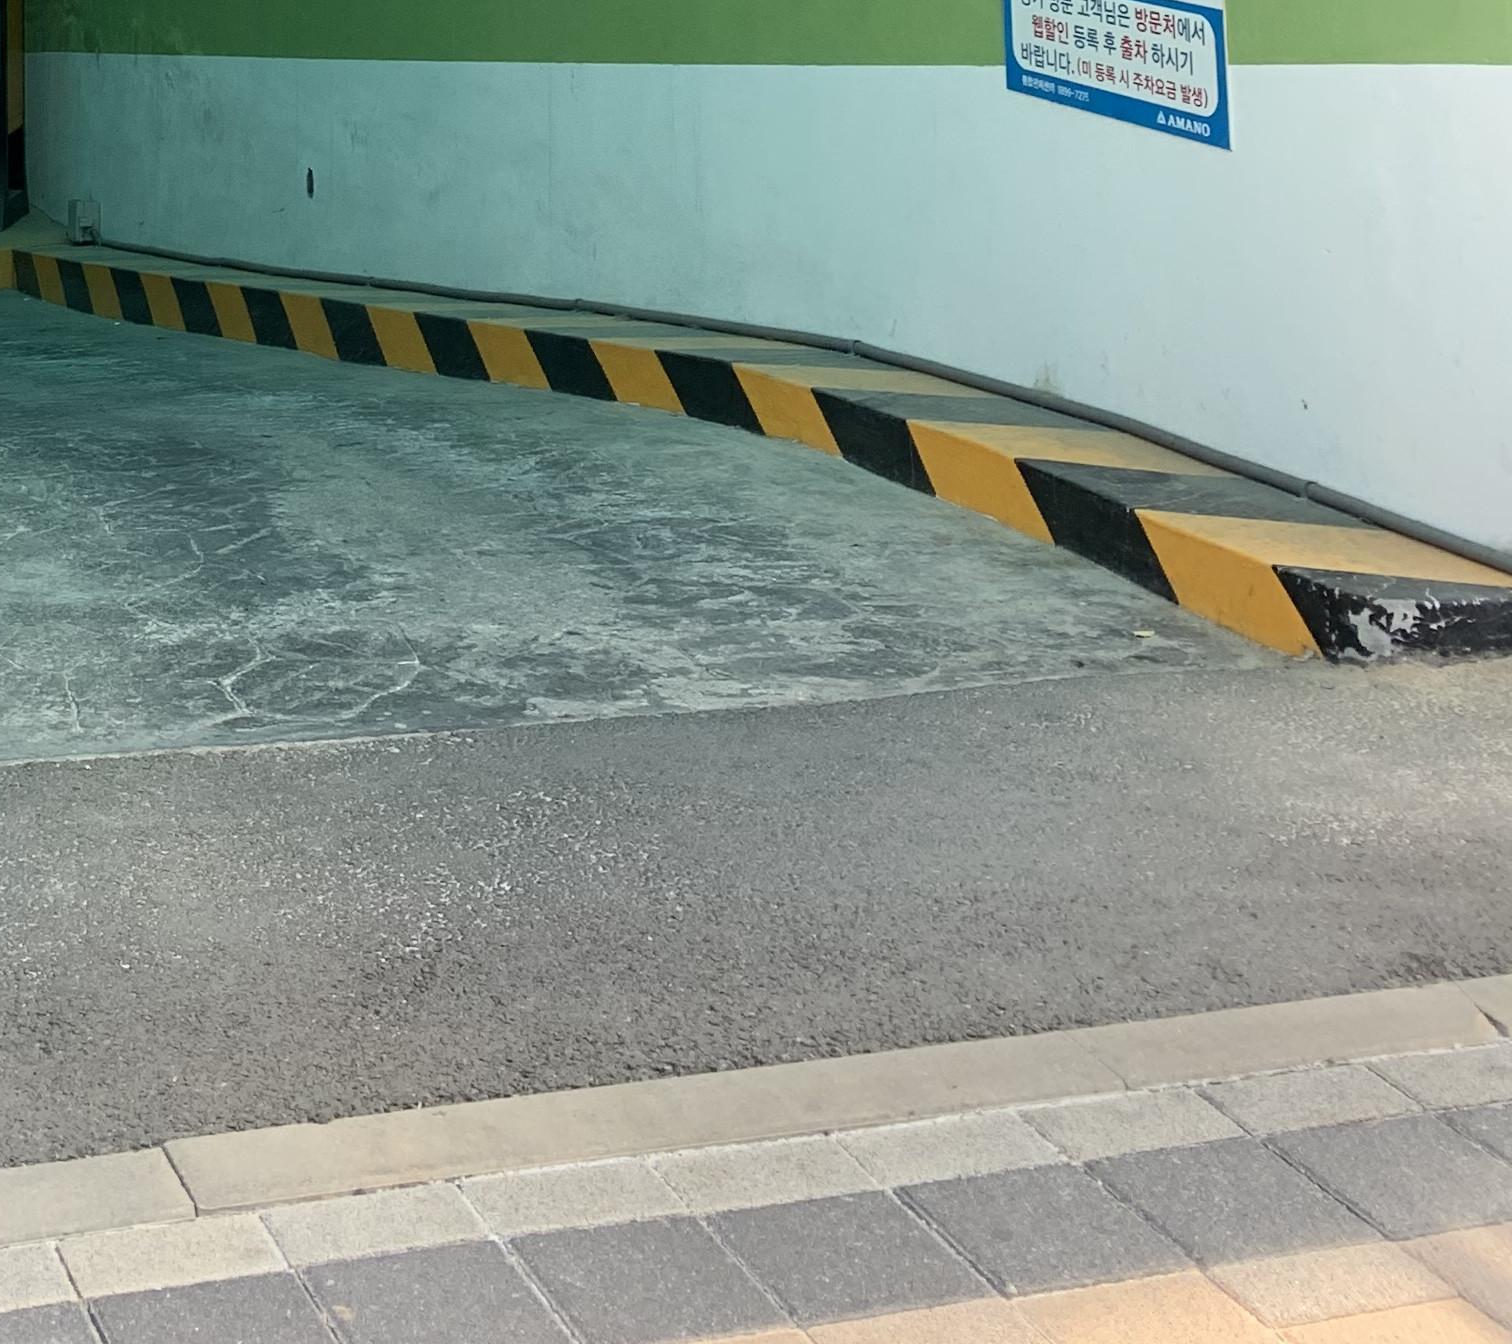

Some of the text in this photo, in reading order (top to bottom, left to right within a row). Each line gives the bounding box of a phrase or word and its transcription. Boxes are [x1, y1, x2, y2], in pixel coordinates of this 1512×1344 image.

[1031, 14, 1194, 76] 웹할인 등록 후 출차 하시기
[1134, 7, 1206, 46] 방문처에서
[1020, 42, 1075, 76] 바랍니다.
[1095, 62, 1117, 86] 등록
[1119, 69, 1130, 89] 시
[1132, 73, 1177, 101] 주차요금
[1179, 85, 1209, 110] 발생)
[1167, 118, 1211, 137] AMANO
